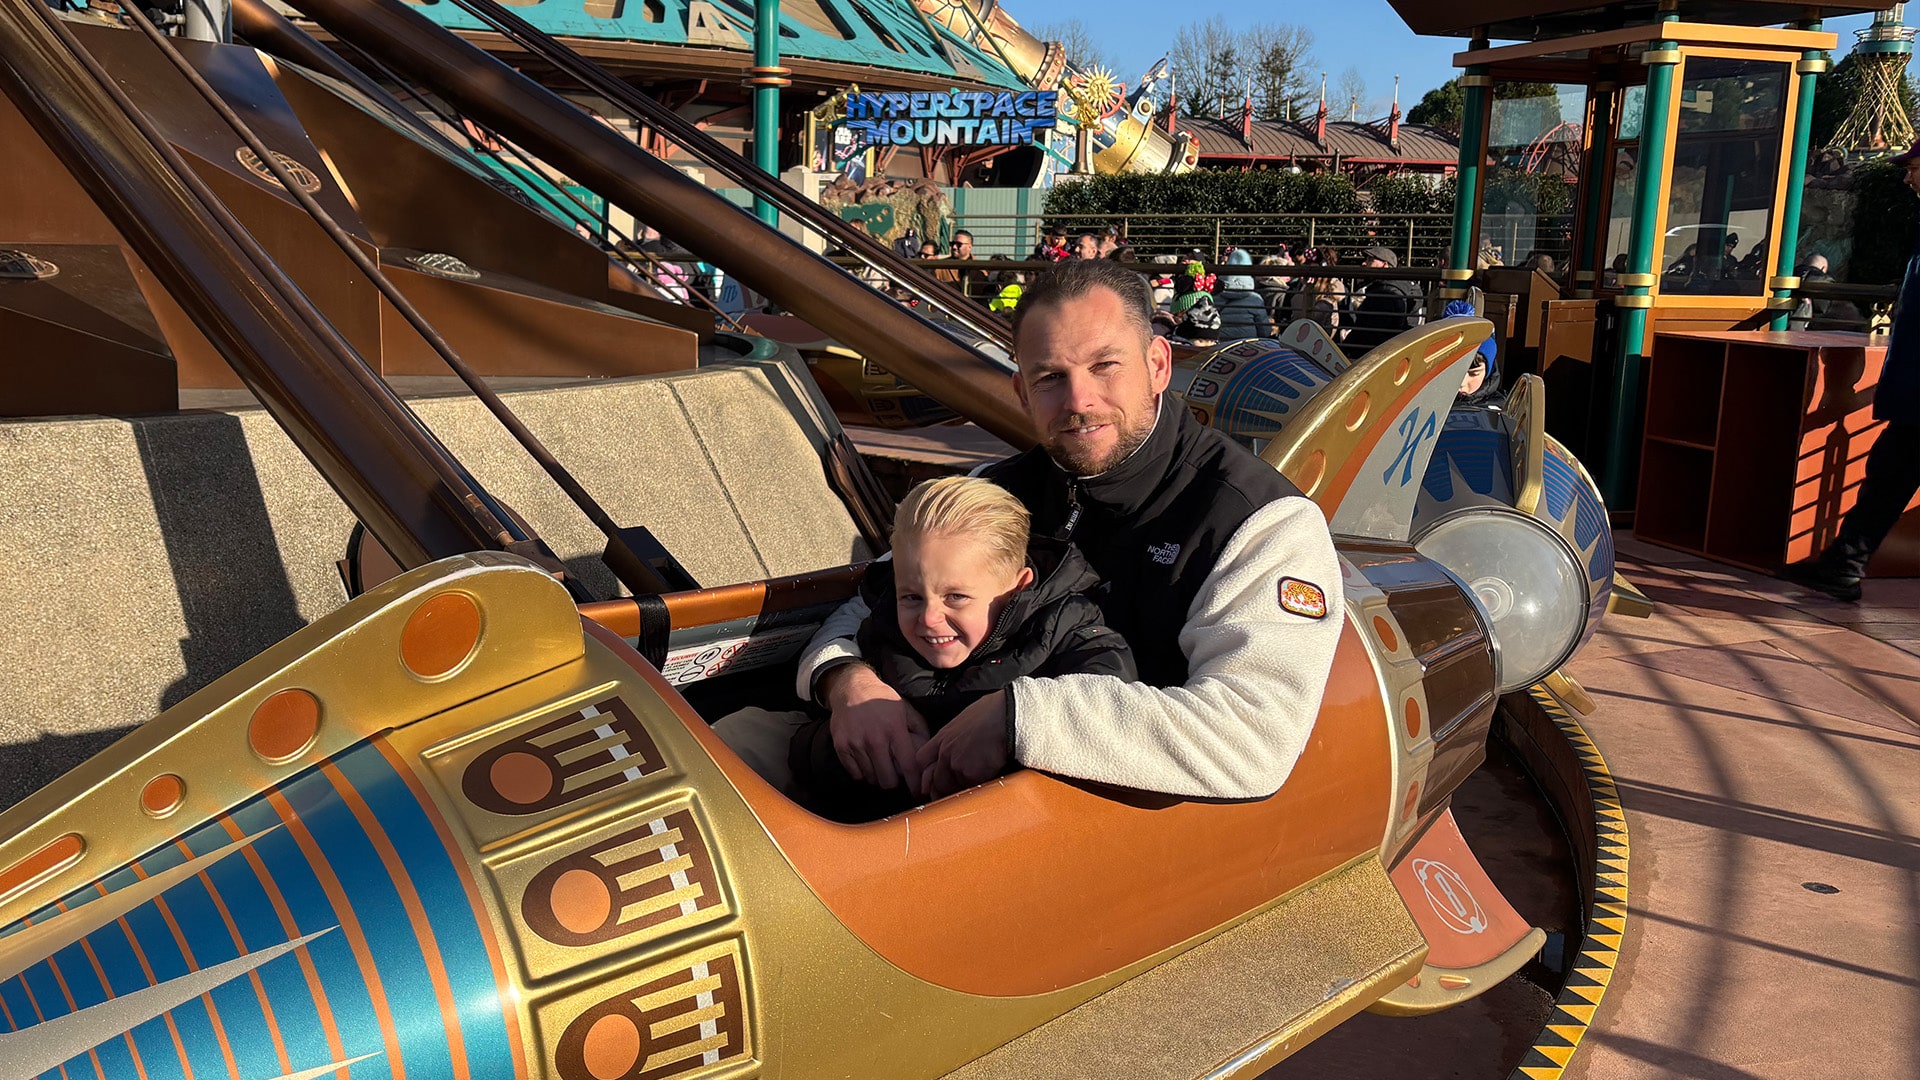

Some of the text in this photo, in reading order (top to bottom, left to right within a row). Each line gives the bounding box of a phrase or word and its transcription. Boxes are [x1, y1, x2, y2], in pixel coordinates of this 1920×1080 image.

[847, 91, 1058, 118] HYPERSPACE
[847, 119, 1056, 145] MOUNTAIN
[1147, 545, 1176, 558] NORTH
[1164, 542, 1177, 552] THE
[1152, 554, 1174, 565] FACE
